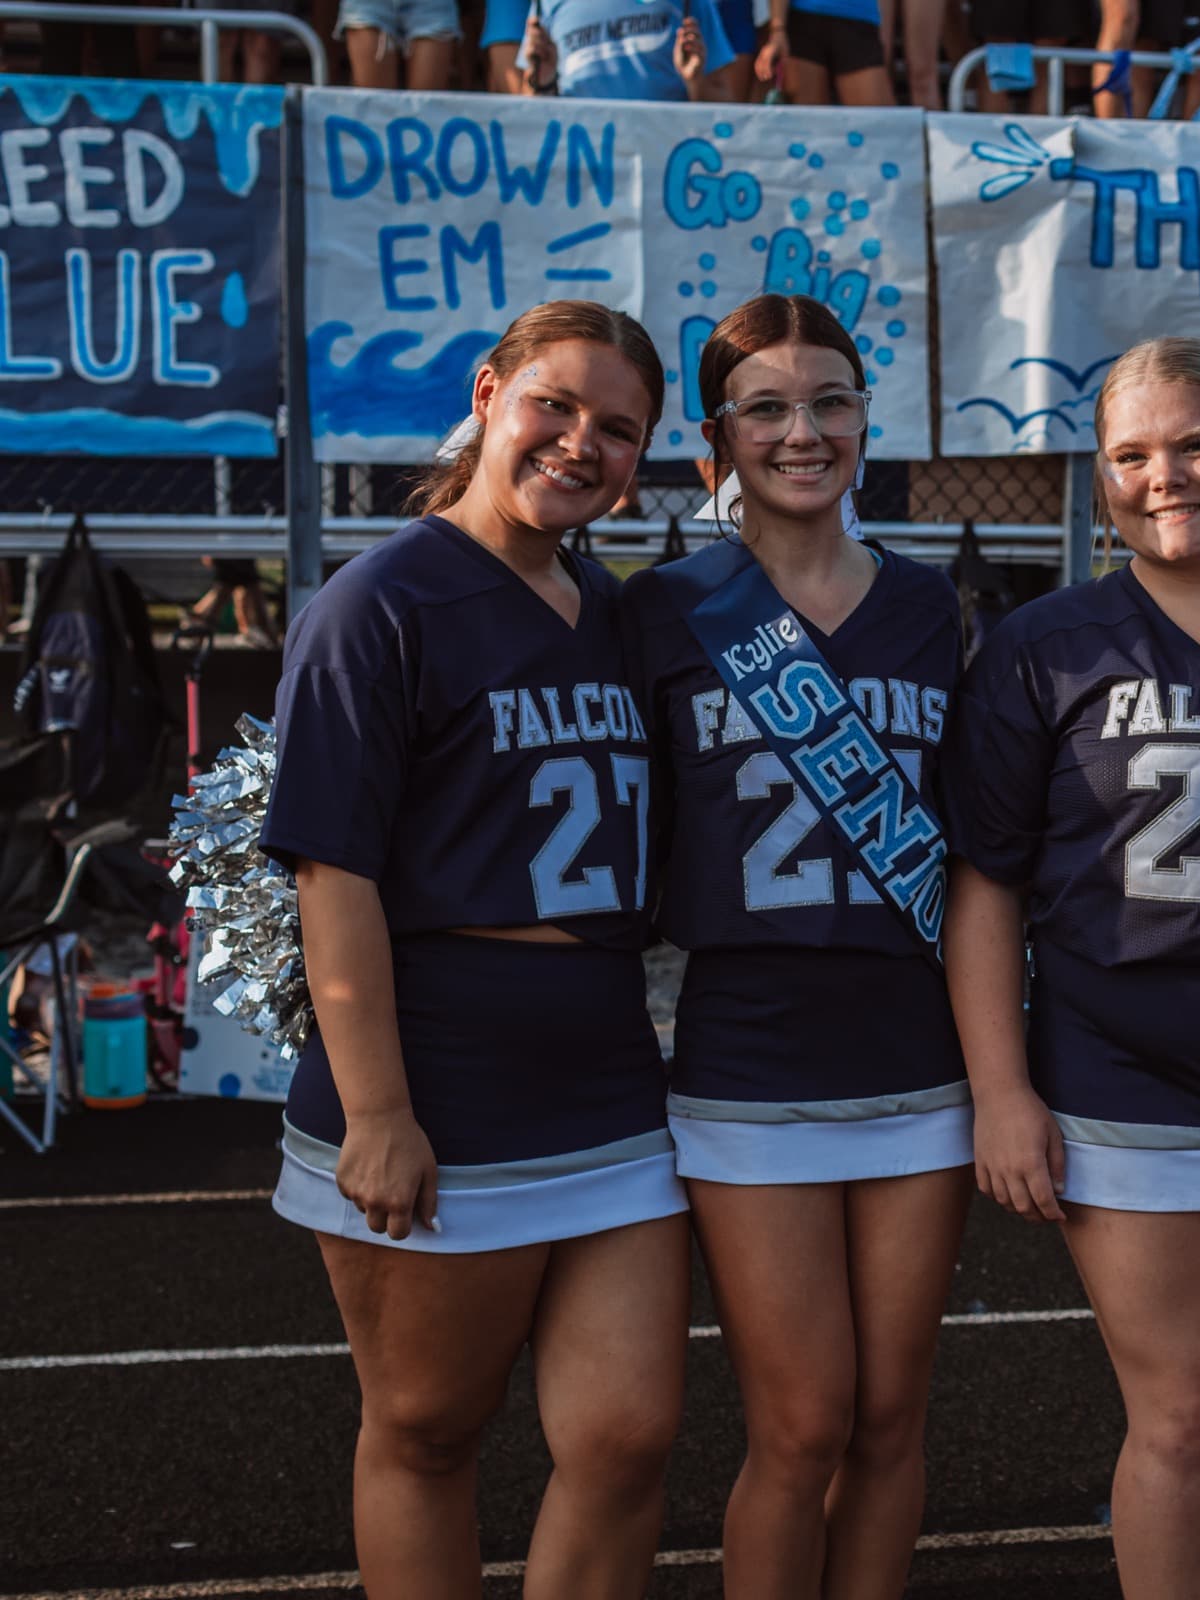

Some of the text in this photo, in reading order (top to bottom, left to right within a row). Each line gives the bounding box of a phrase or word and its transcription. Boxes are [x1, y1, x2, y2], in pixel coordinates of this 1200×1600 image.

[0, 127, 185, 228] EED
[324, 114, 616, 208] DROWN
[664, 138, 763, 231] Go
[378, 220, 507, 312] EM
[764, 228, 871, 335] Big
[720, 617, 798, 682] Kylie
[691, 677, 948, 753] FAONS
[528, 752, 650, 920] 27
[748, 659, 949, 963] SENIO
